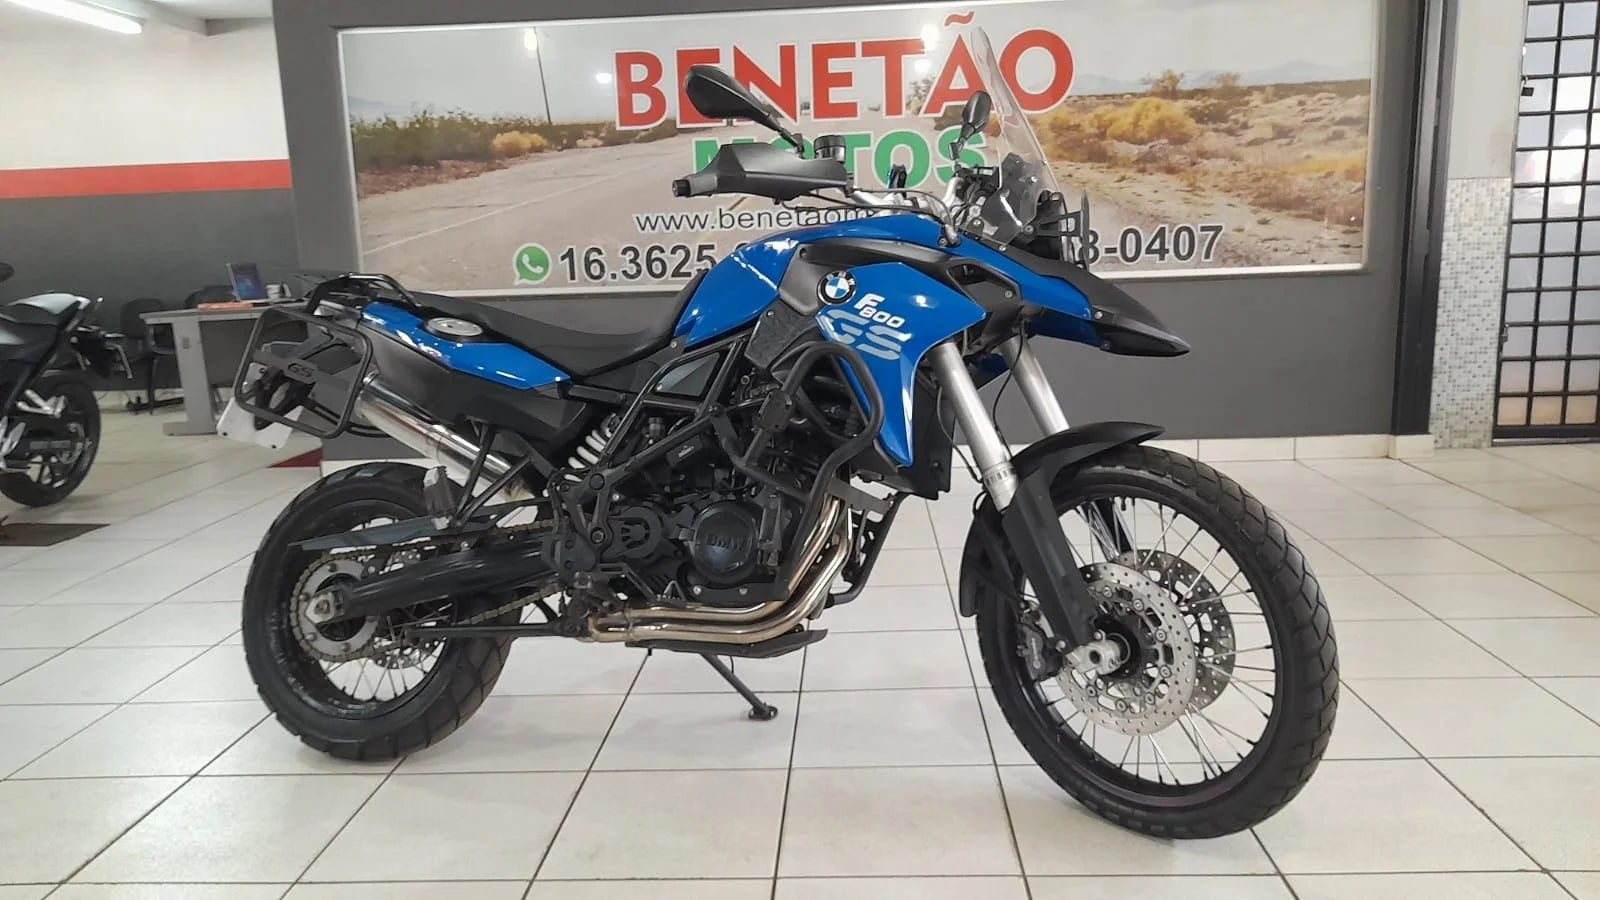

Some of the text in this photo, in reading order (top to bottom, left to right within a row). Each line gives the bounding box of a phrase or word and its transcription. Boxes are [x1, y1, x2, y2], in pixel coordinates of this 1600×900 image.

[614, 12, 1074, 128] BENETÃO
[854, 293, 885, 310] F
[859, 307, 905, 328] 800
[816, 309, 912, 360] GS
